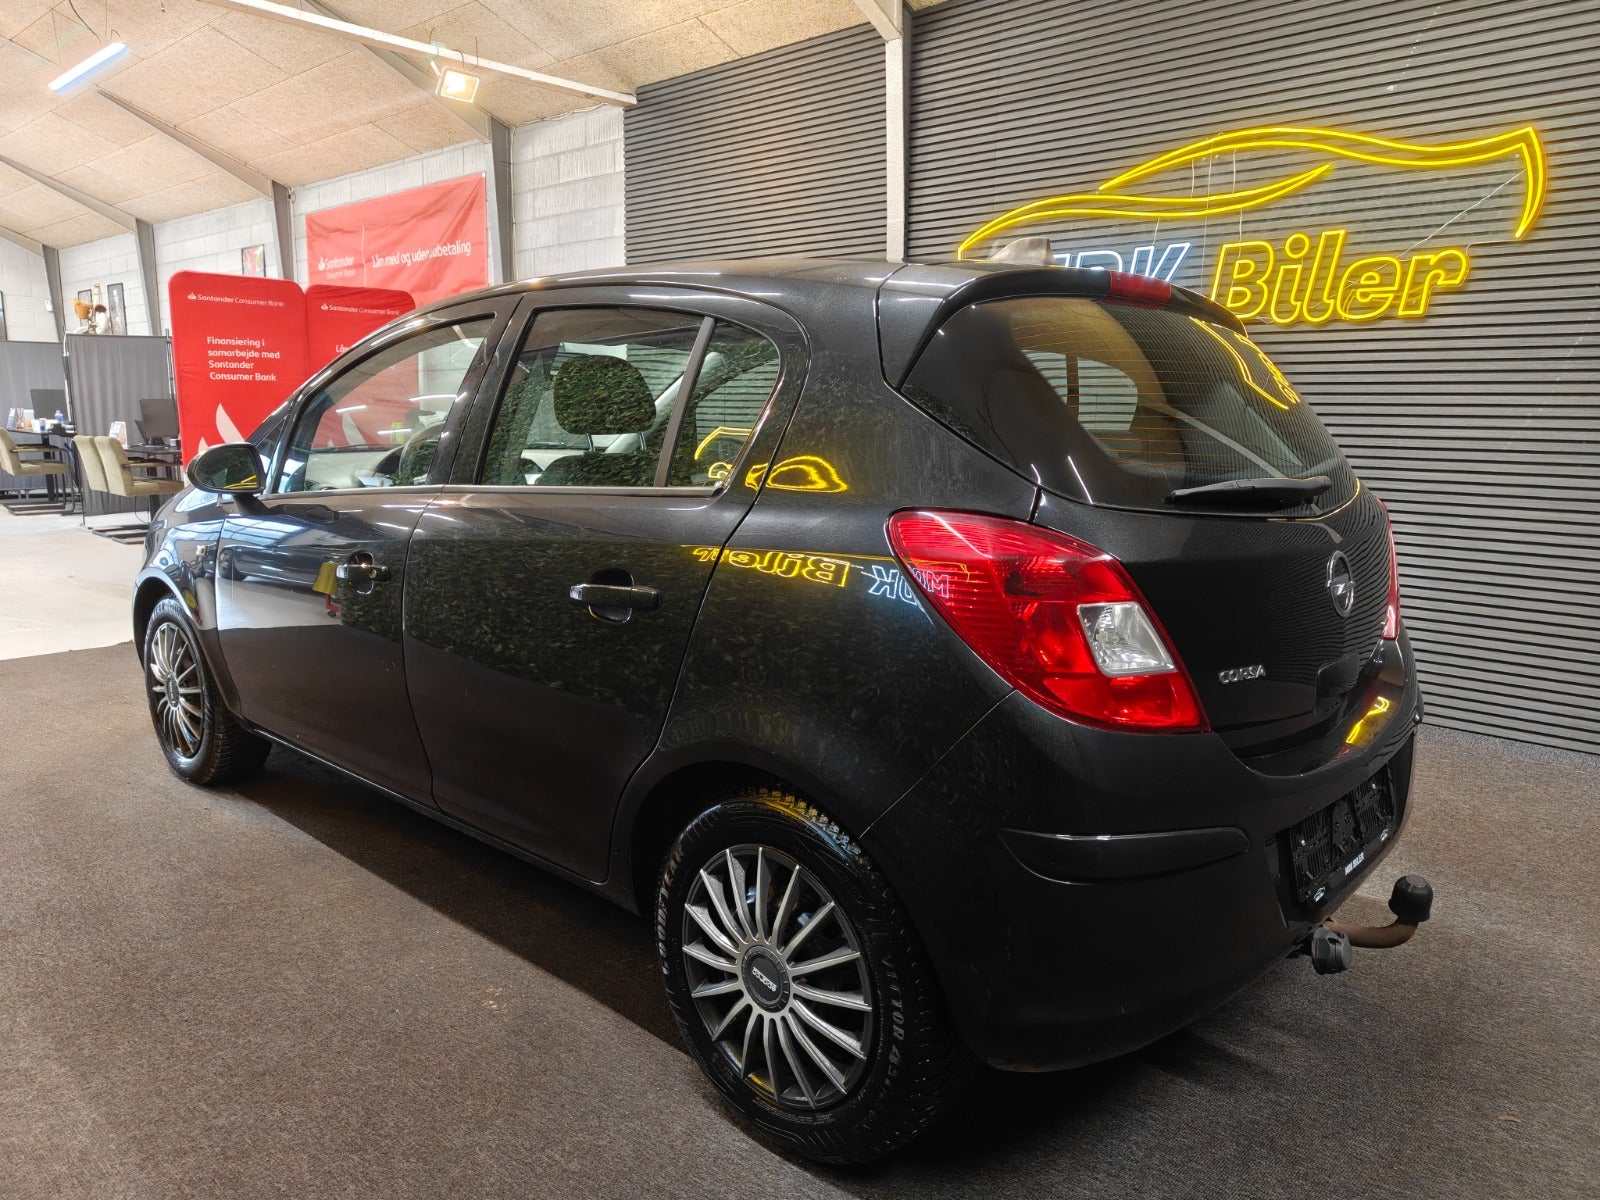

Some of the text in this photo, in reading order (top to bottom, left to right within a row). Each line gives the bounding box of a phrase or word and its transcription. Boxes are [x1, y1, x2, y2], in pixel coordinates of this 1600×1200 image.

[372, 255, 384, 268] Lån
[384, 251, 400, 265] med
[401, 252, 411, 266] og
[1211, 228, 1470, 325] Biler
[197, 294, 234, 303] Santander
[234, 297, 267, 306] Consumer
[329, 304, 358, 313] Santander
[359, 306, 385, 315] Consumer
[207, 336, 261, 348] Finansiering
[207, 349, 280, 359] samarbejde med
[208, 360, 254, 369] Santander
[209, 371, 277, 381] Consumer Bank
[1218, 664, 1266, 685] CORSA
